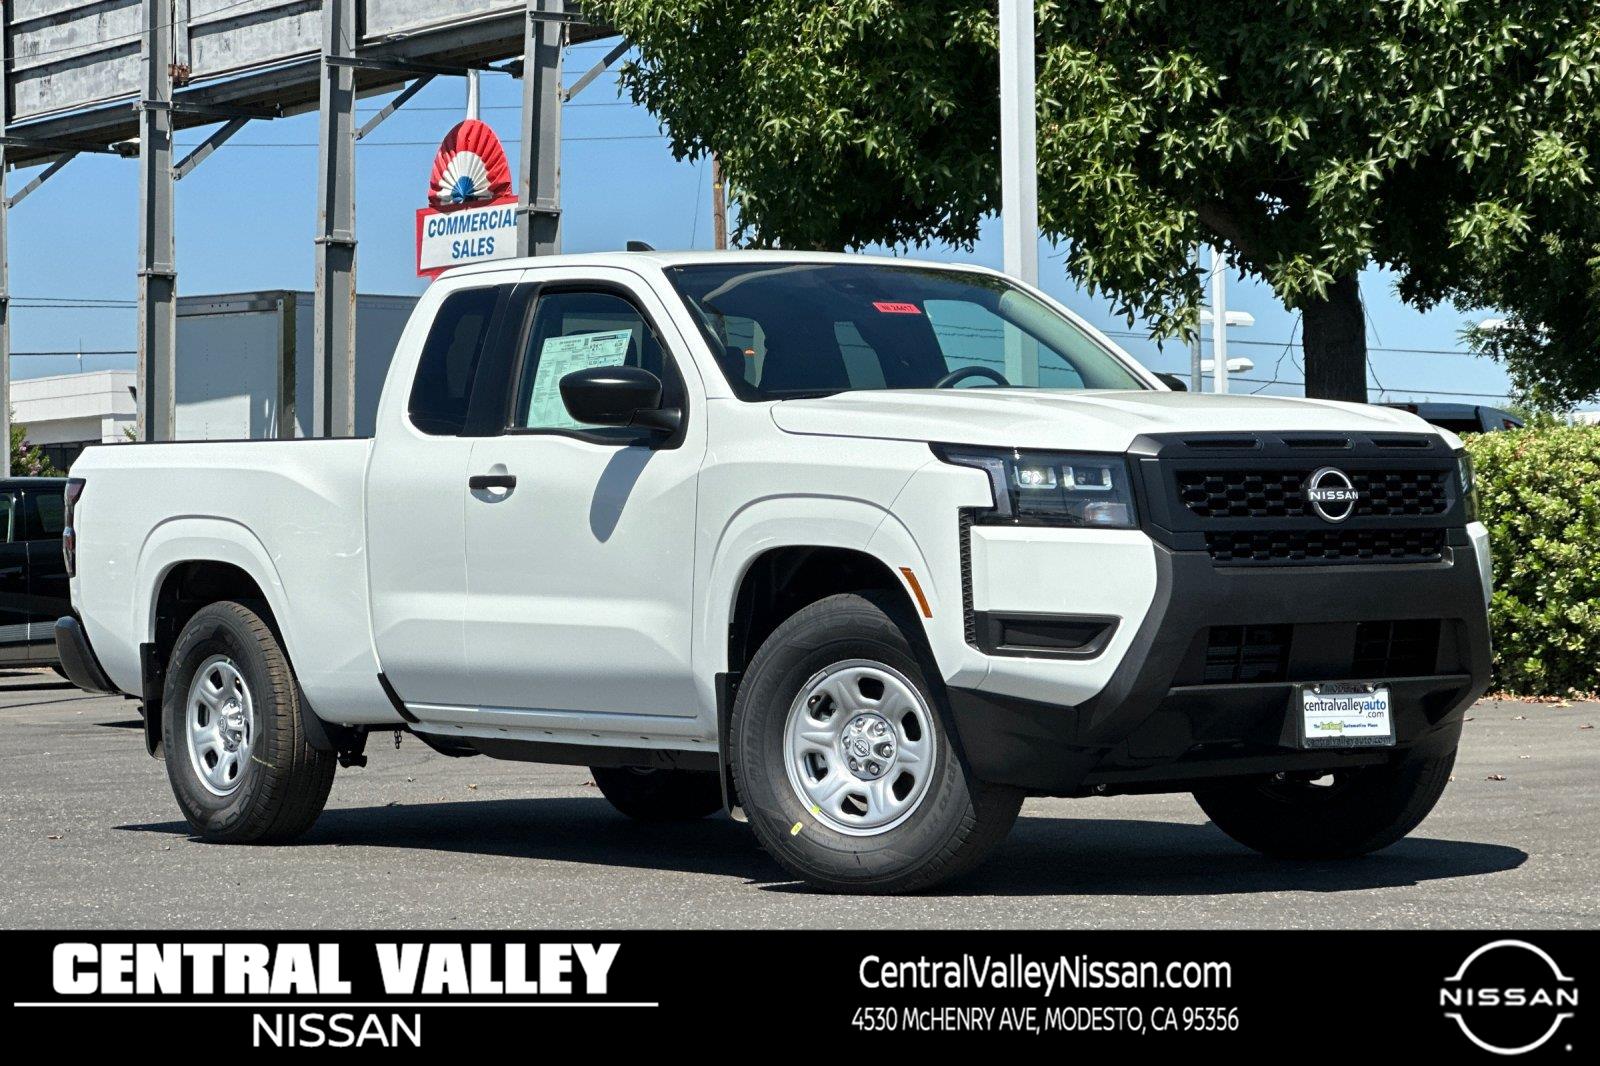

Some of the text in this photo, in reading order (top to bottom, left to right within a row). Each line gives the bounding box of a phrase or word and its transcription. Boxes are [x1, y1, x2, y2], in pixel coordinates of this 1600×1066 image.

[452, 237, 494, 259] SALES
[1310, 491, 1358, 500] NISSAN
[1304, 698, 1387, 714] centralvalleyauto
